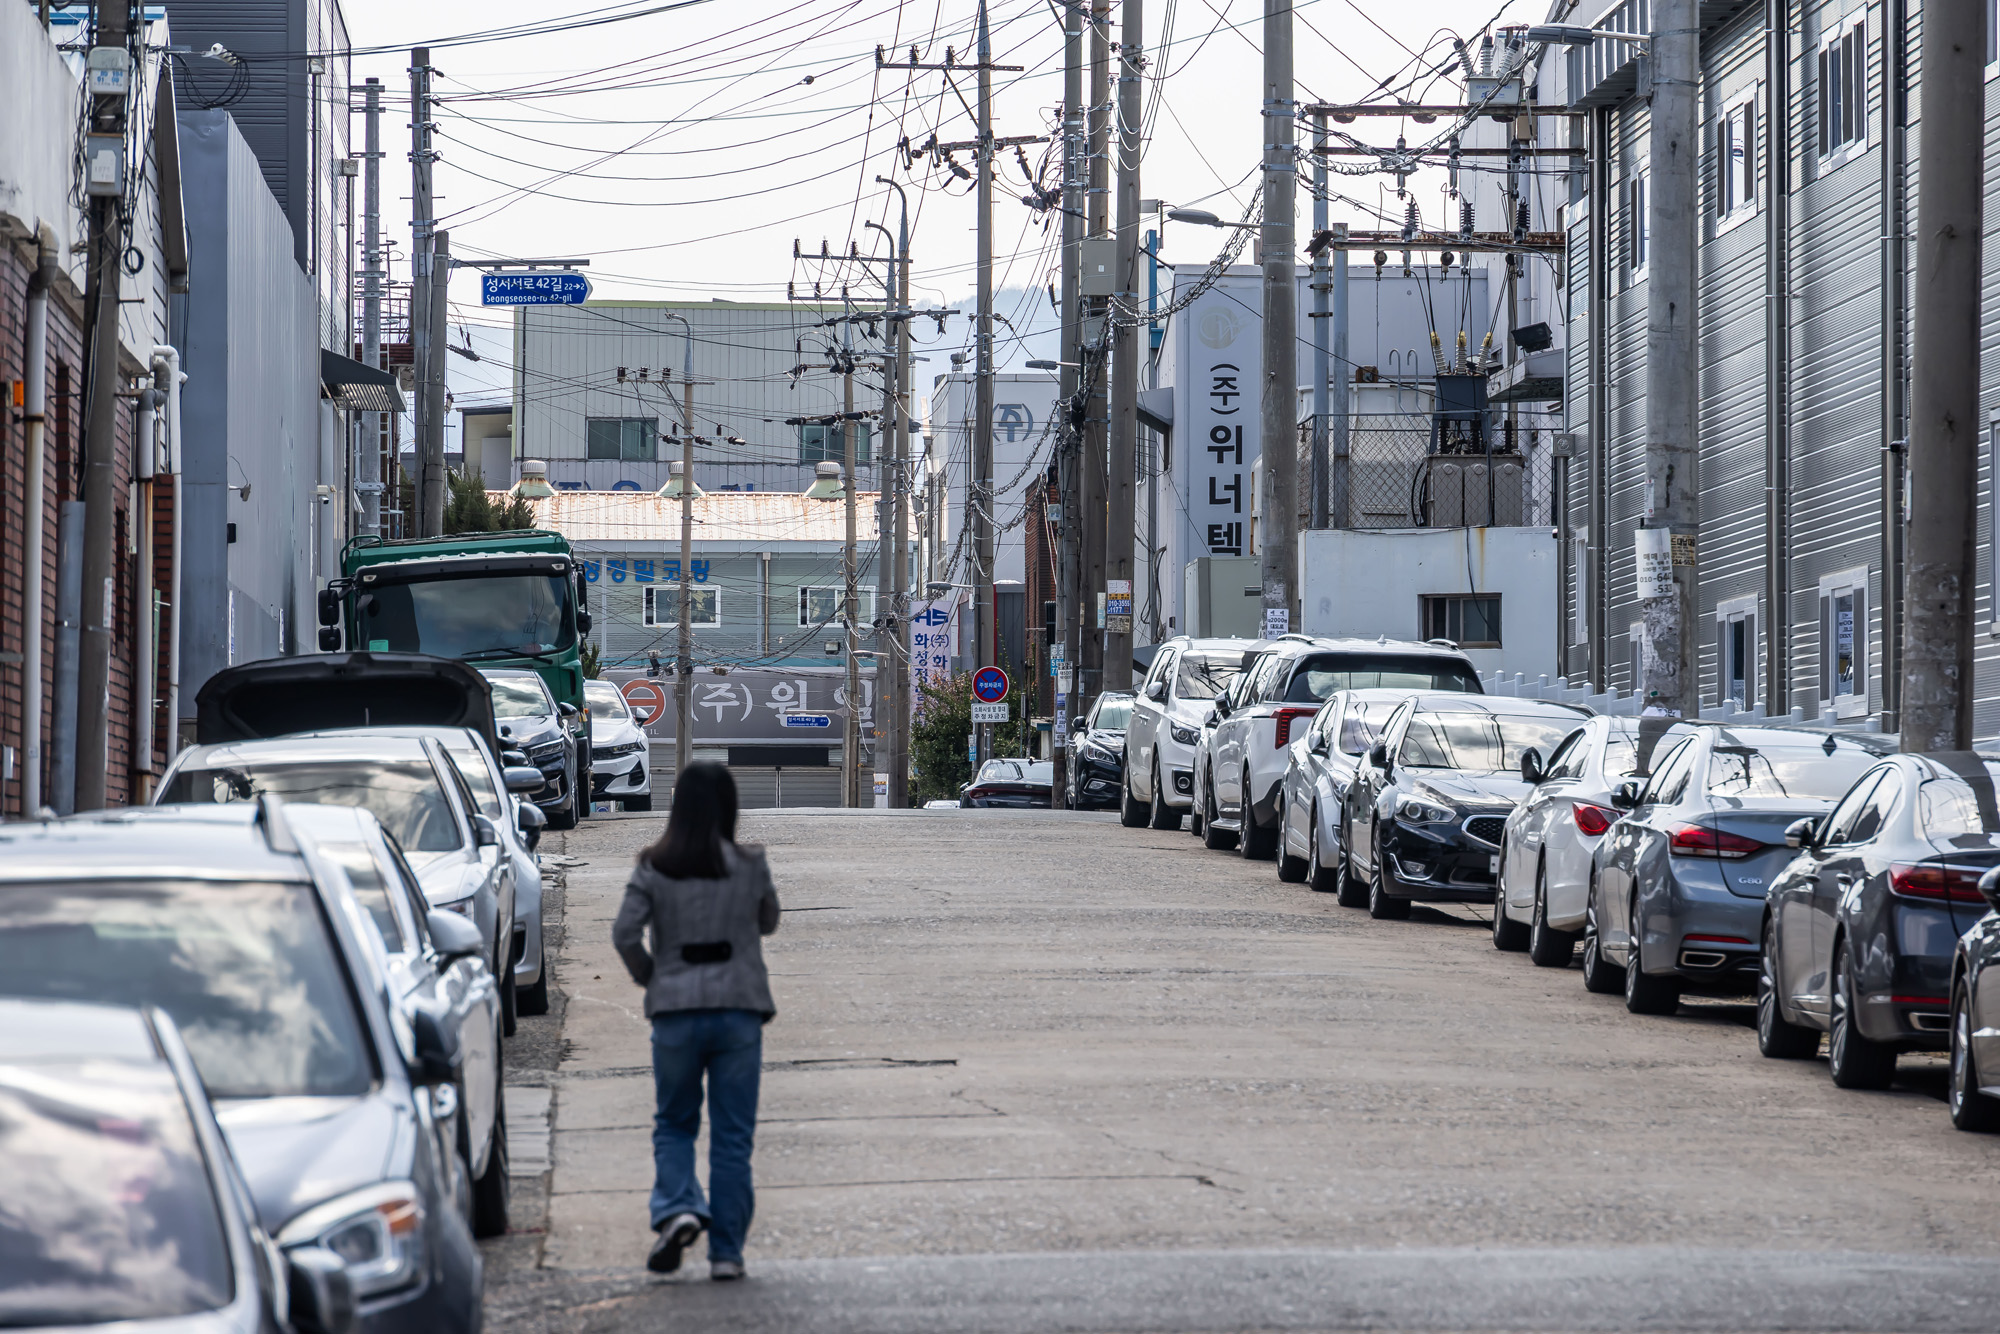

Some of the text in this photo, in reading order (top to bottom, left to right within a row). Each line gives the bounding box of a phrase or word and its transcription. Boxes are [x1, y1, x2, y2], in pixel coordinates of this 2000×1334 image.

[486, 293, 572, 304] Seongseoseo-ro 42-gil
[1738, 876, 1763, 885] G80
